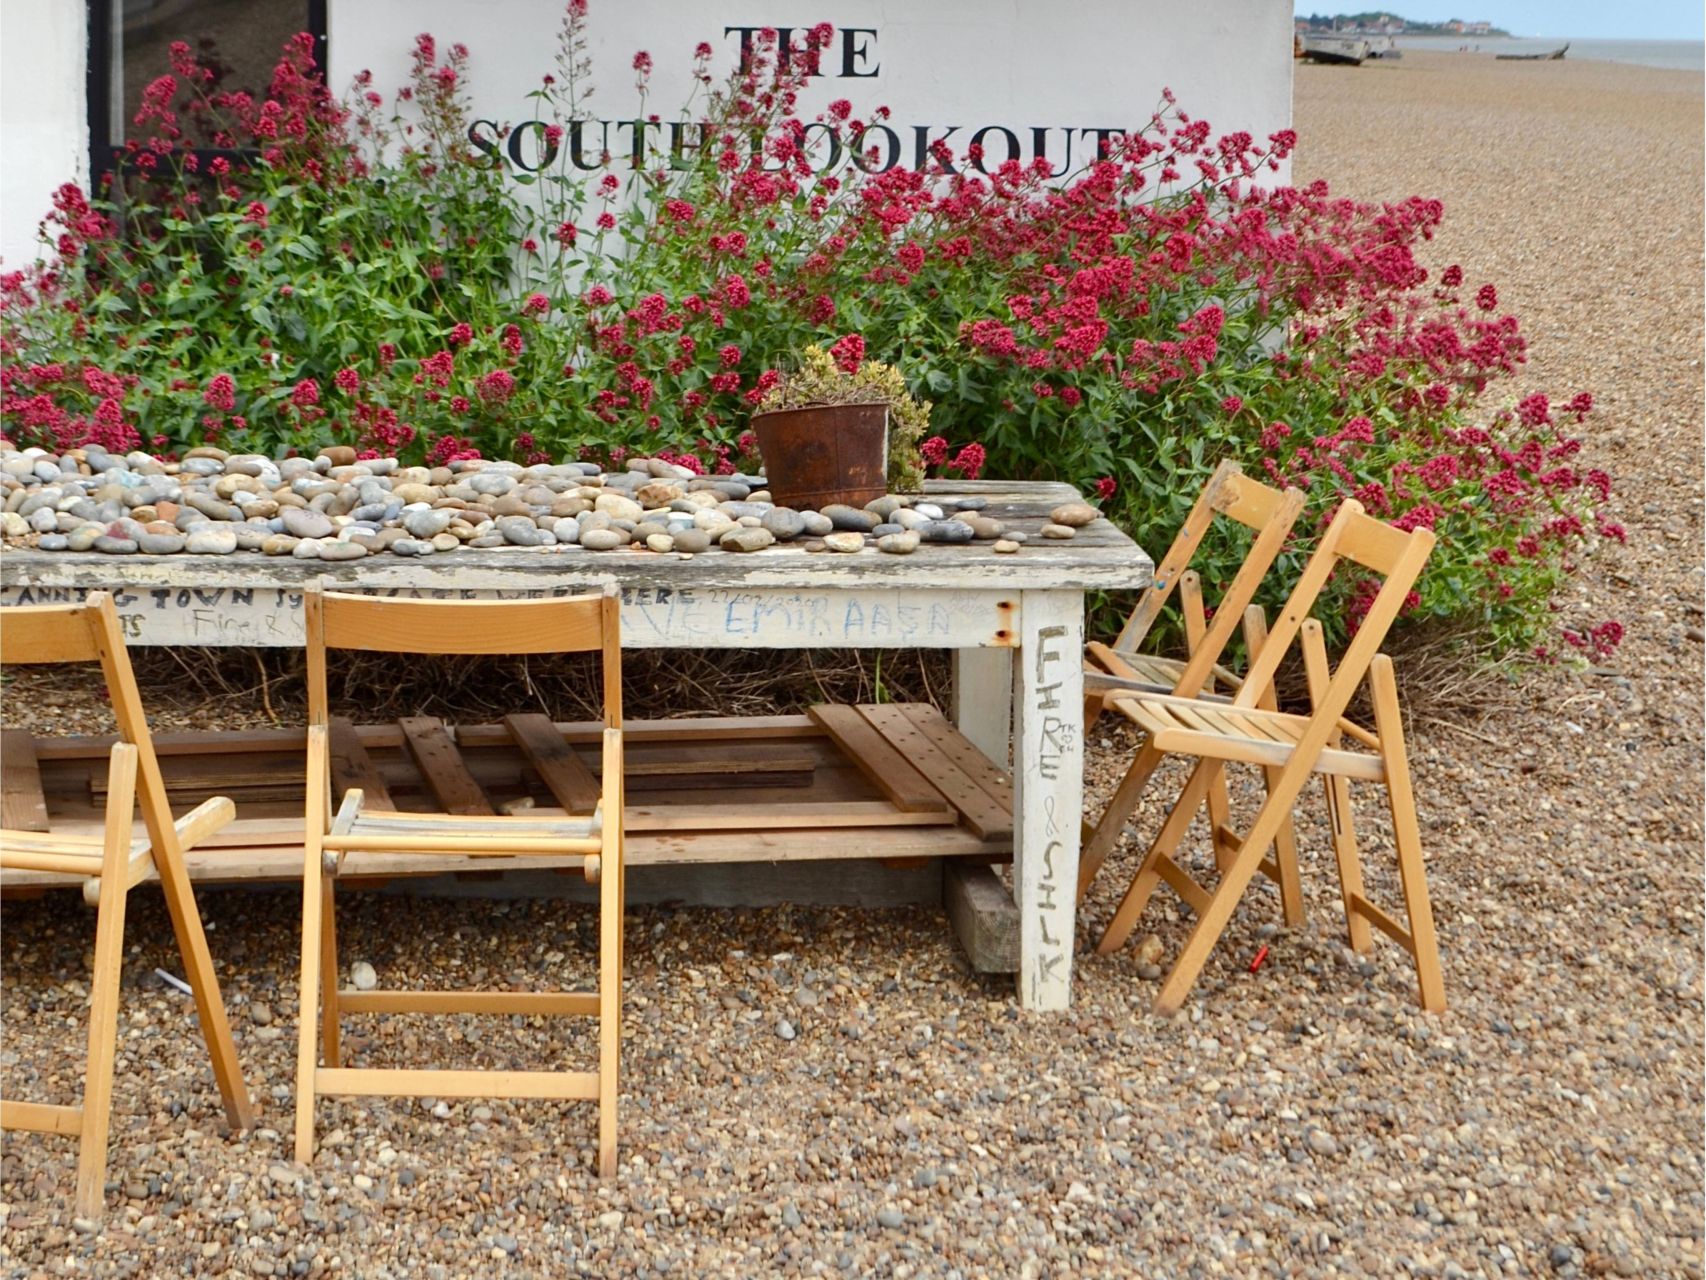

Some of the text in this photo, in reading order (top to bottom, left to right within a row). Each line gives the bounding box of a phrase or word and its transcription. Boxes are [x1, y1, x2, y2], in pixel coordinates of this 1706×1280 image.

[725, 26, 881, 77] THE
[467, 119, 1128, 178] SOUTH LOOKOUT
[1, 587, 138, 607] CANNIG
[151, 588, 254, 609] TOWN
[1036, 625, 1068, 780] FIRE
[1037, 840, 1065, 983] SILK
